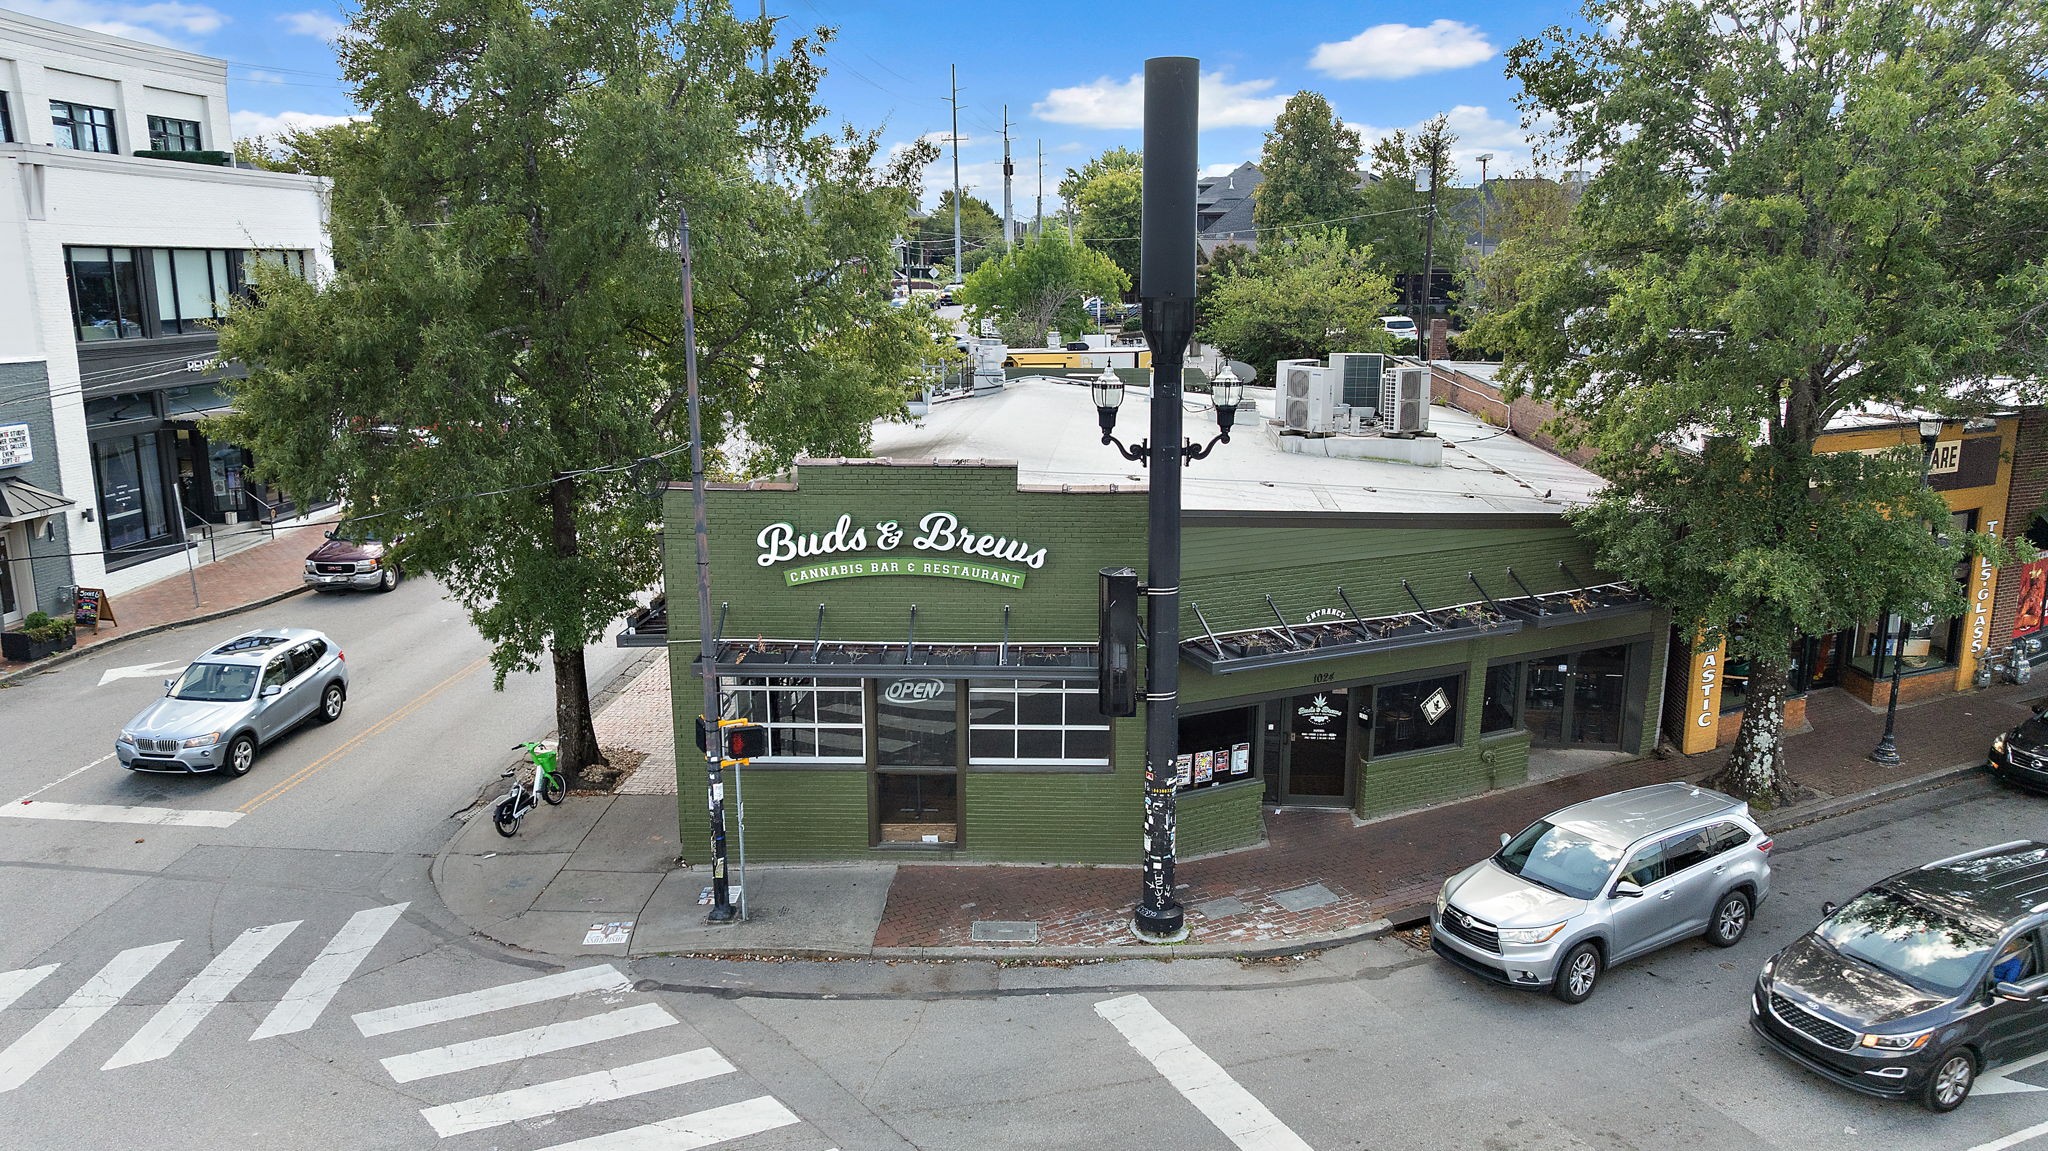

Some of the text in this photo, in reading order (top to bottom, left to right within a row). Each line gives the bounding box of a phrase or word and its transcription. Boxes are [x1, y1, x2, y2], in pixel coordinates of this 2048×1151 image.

[757, 511, 1048, 569] Buds & Brews
[790, 563, 863, 583] CANNABIS
[871, 562, 899, 574] BAR
[924, 562, 1020, 585] RESTAURANT
[1305, 608, 1346, 623] ENTRANCE
[1313, 671, 1335, 683] 1024
[1697, 625, 1718, 727] ASTIC
[889, 682, 938, 699] OPEN
